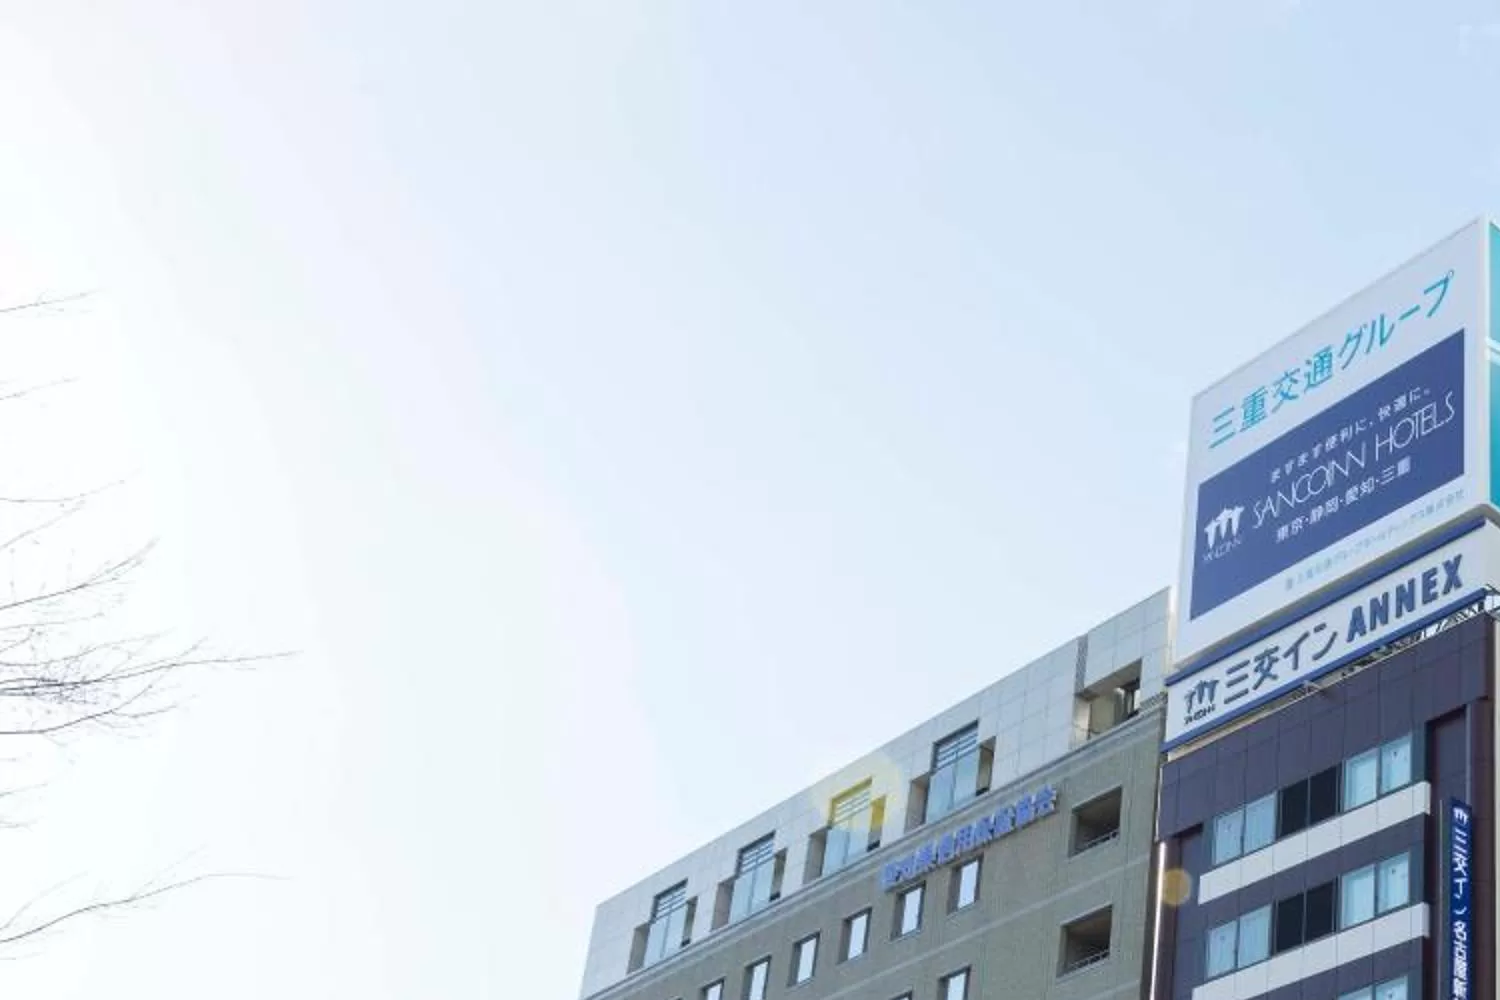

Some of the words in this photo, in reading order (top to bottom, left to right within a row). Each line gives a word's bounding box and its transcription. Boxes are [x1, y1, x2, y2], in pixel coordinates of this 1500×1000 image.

[1209, 269, 1455, 449] 三重交通グループ
[1375, 391, 1455, 460] HOTELS
[1223, 620, 1338, 705] 三交イン
[1346, 554, 1465, 643] ANNEX
